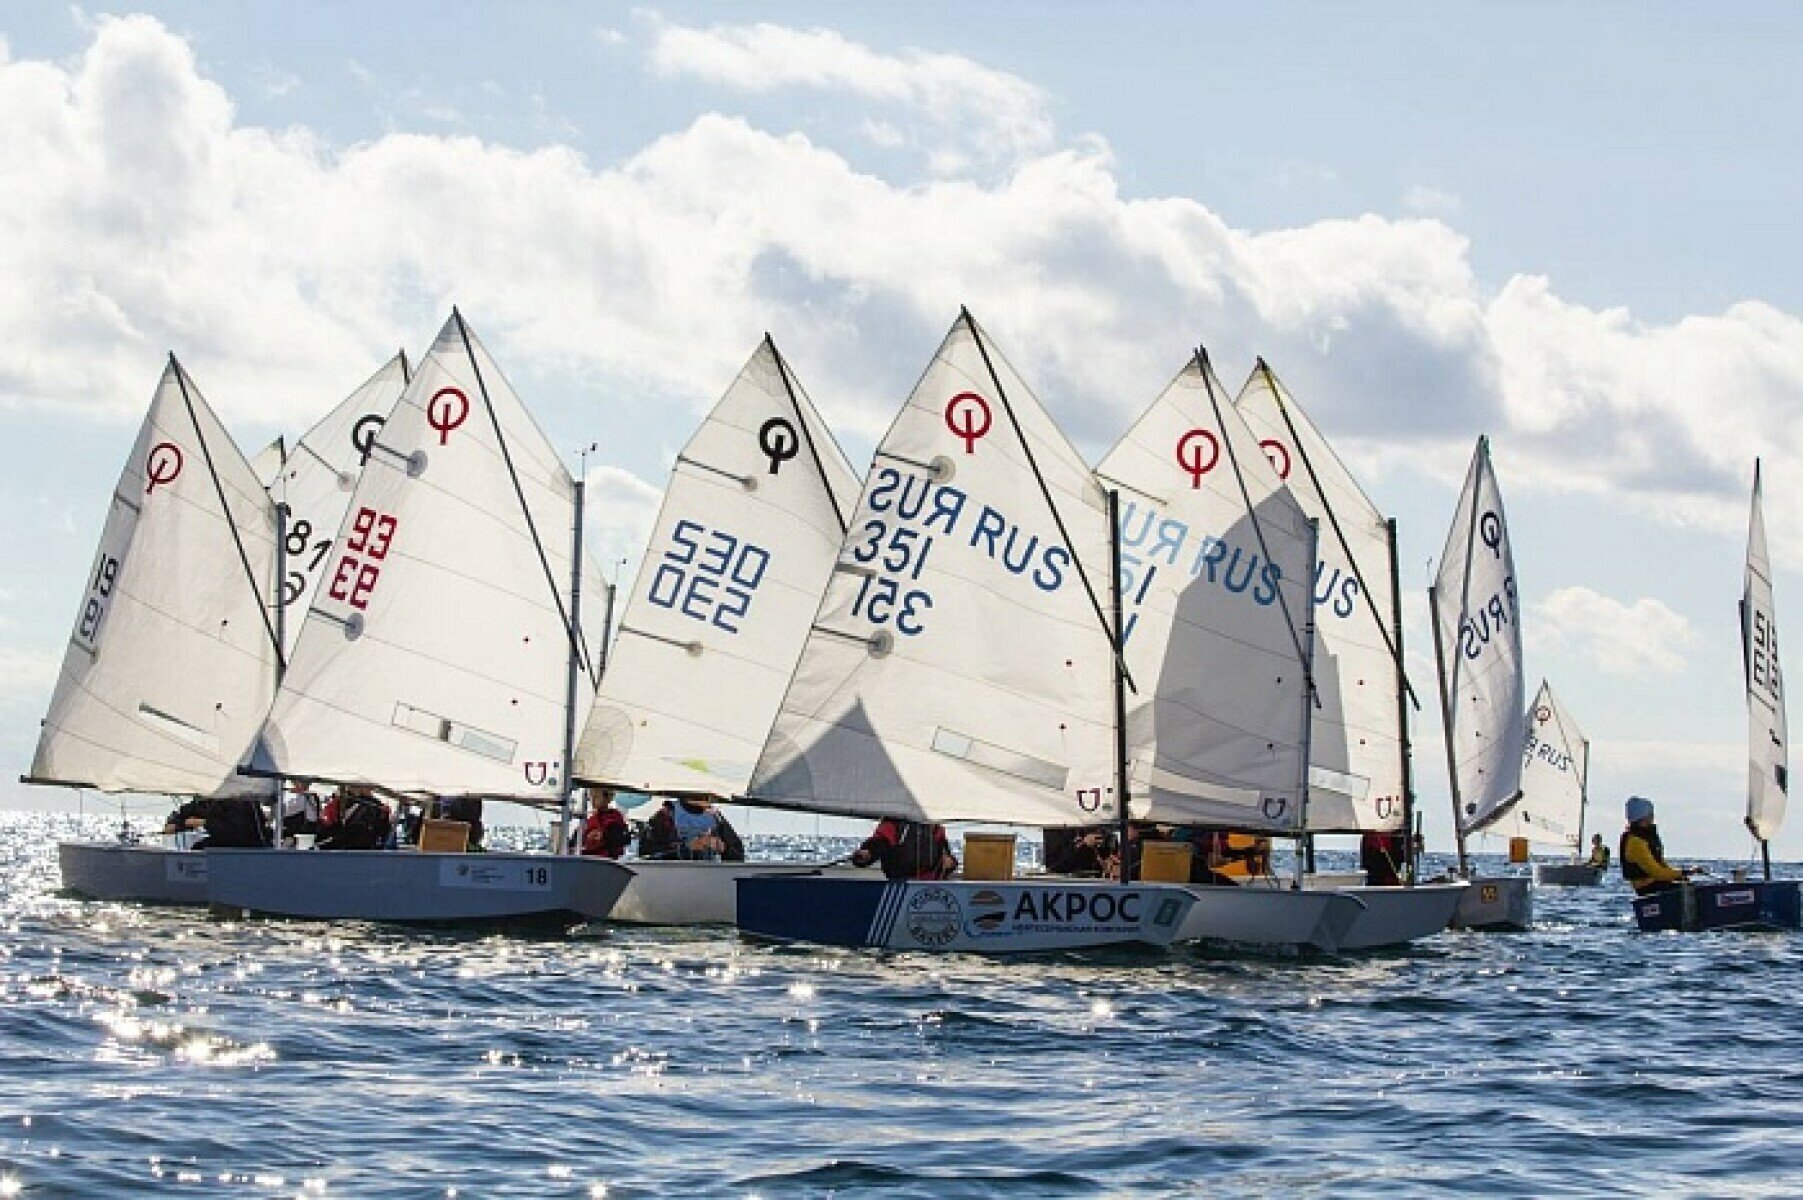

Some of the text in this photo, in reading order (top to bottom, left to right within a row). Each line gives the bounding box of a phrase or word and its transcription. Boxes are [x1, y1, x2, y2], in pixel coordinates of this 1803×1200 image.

[347, 506, 397, 560] 93
[664, 519, 771, 590] 530
[853, 519, 933, 580] 351
[969, 504, 1071, 592] RUS
[1190, 534, 1283, 606] RUS
[525, 867, 547, 885] 18
[1013, 890, 1140, 923] АКРОС
